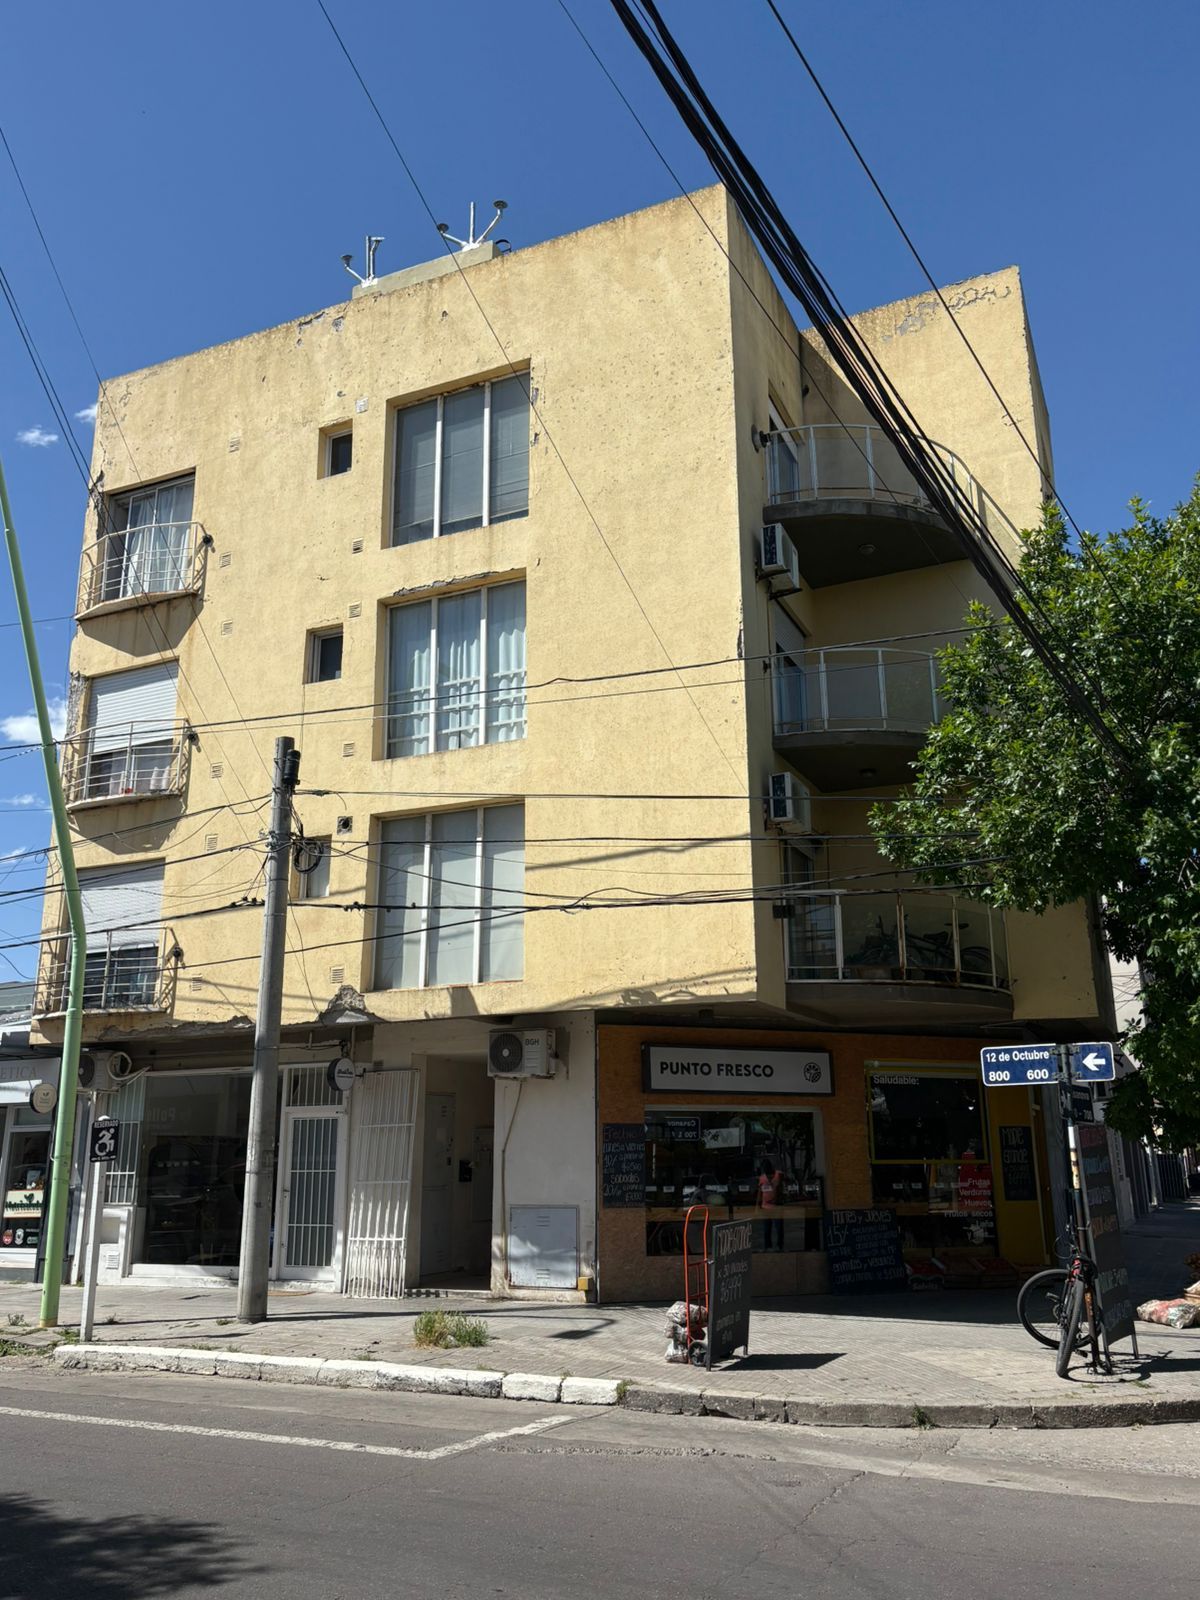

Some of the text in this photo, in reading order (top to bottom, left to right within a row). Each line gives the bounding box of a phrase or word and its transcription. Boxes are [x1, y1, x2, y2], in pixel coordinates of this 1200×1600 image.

[525, 1038, 540, 1046] BGH
[986, 1050, 1050, 1062] 12 de Octubre
[660, 1061, 774, 1078] PUNTO FRESCO
[988, 1069, 1049, 1081] 800 600
[873, 1075, 920, 1086] Saludable:
[94, 1120, 118, 1129] RESERVADO
[968, 1178, 990, 1186] Frutas
[959, 1188, 991, 1197] Verduras
[971, 1210, 994, 1218] secos
